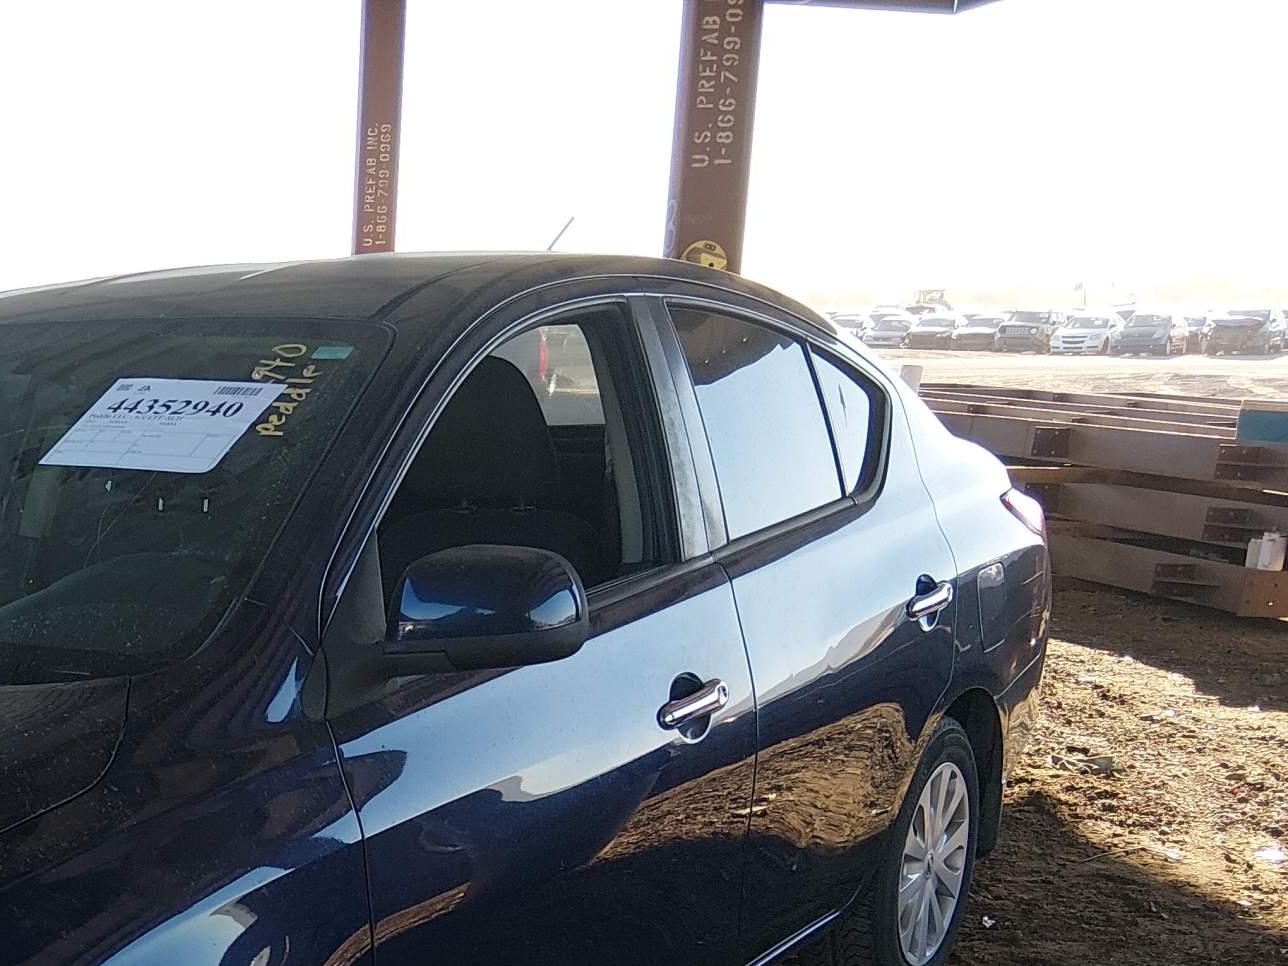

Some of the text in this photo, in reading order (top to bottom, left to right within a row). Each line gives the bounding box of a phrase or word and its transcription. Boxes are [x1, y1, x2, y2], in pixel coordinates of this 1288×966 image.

[691, 15, 721, 168] U.S. PREFAB
[362, 122, 379, 247] U.S. PREFAB INC.
[375, 123, 392, 245] 1-866-799-0969
[107, 398, 244, 418] 44352940
